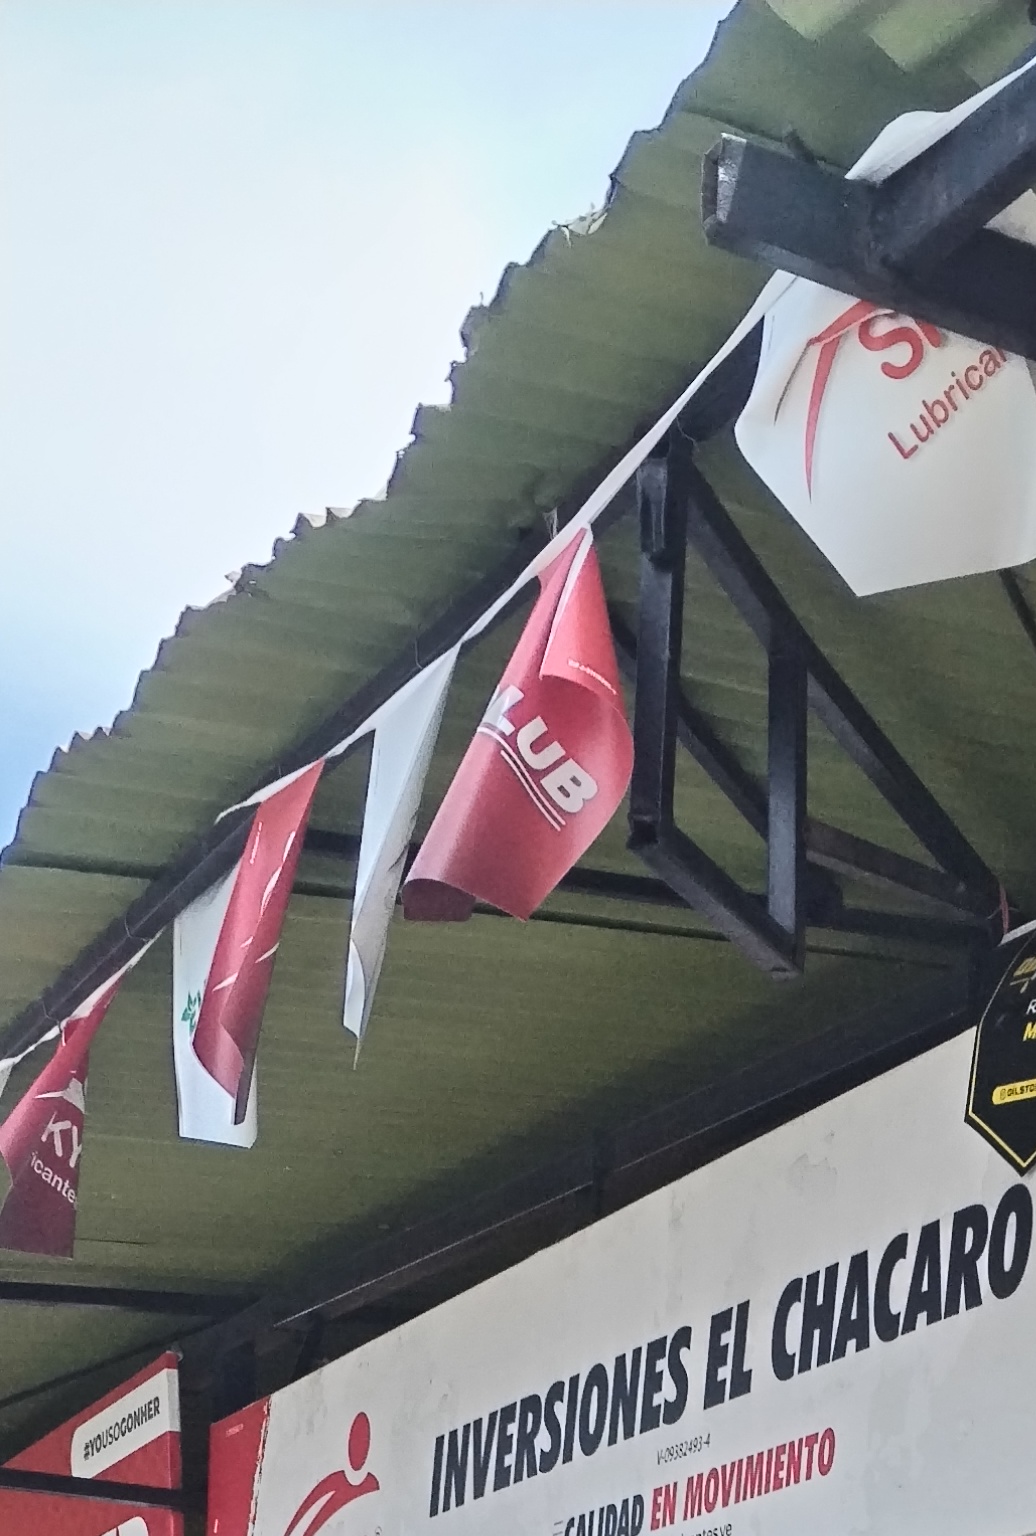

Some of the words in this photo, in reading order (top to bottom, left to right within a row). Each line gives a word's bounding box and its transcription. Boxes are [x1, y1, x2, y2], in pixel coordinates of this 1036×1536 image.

[428, 1325, 692, 1518] INVERSIONES
[703, 1300, 752, 1411] EL
[771, 1183, 1034, 1382] CHACARO
[83, 1395, 161, 1461] #YOUSOGONHER
[650, 1480, 678, 1532] EN
[682, 1427, 837, 1522] MOVIMIENTO
